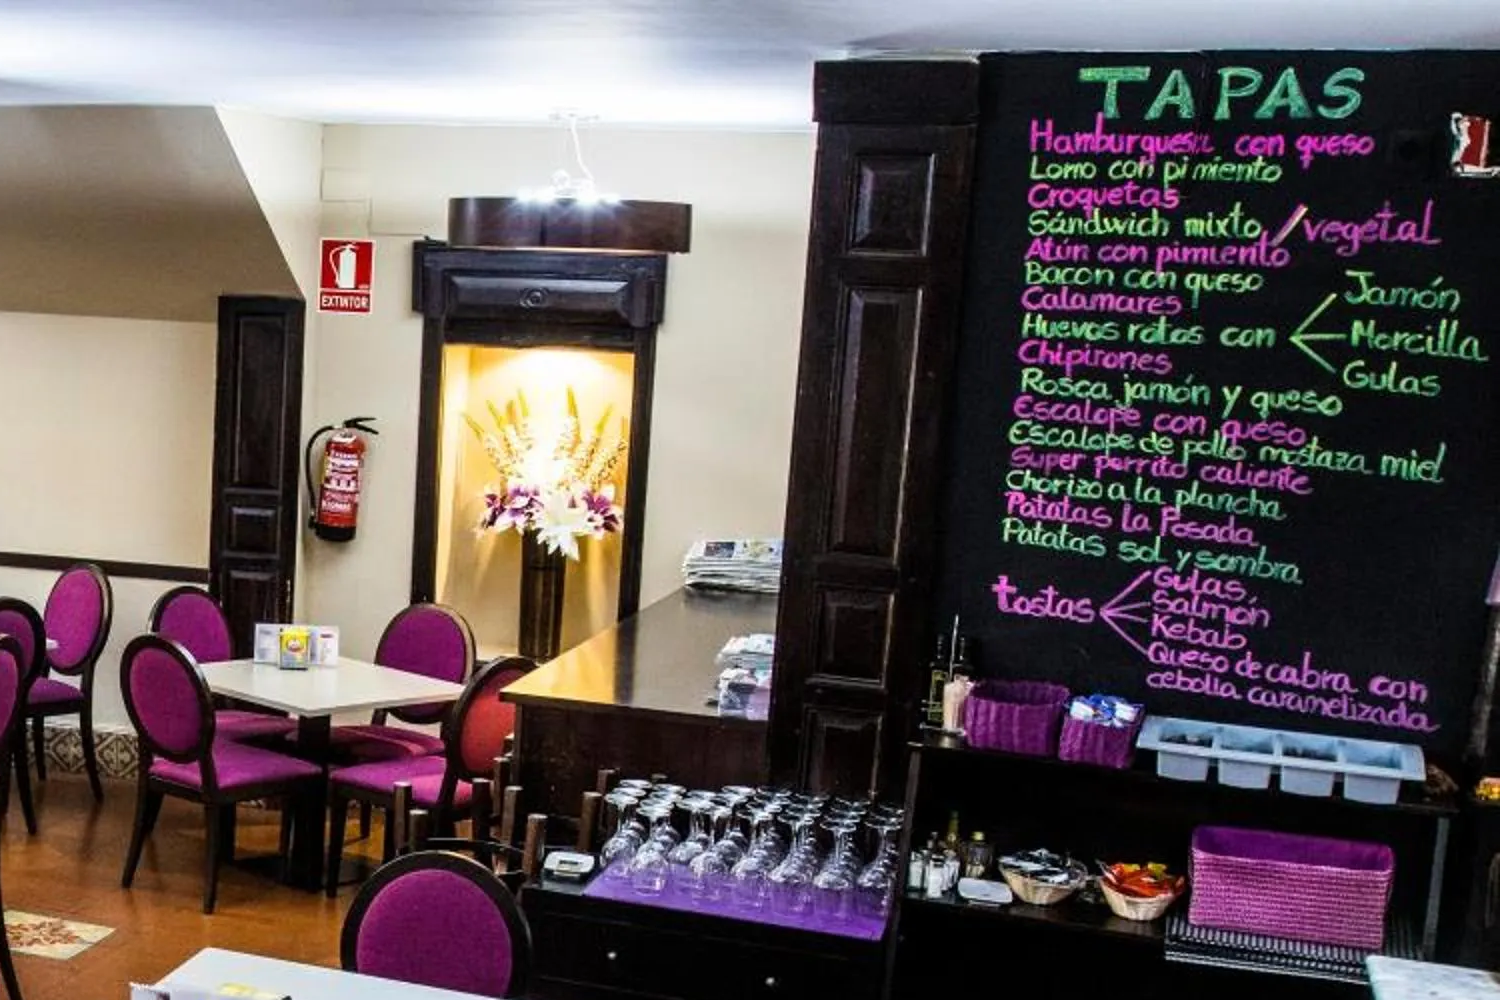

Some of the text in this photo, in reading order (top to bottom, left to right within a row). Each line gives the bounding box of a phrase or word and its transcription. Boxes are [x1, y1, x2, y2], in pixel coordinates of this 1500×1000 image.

[1079, 66, 1365, 120] TAPAS
[1029, 112, 1376, 169] Hamburguesa con queso
[1029, 154, 1097, 181] Lomo
[1108, 158, 1155, 181] con
[1027, 180, 1180, 218] Croquetas
[1027, 207, 1171, 238] Sándwich
[1184, 201, 1263, 239] mixto
[1303, 199, 1442, 257] vegetal
[1024, 230, 1291, 276] Atún con pimiento
[1020, 285, 1183, 316] Calamares
[1024, 260, 1264, 309] Bacon con queso
[1344, 268, 1461, 313] Jamón
[1021, 312, 1276, 348] Huevos rotos con
[1351, 318, 1489, 362] Morcilla
[1017, 338, 1173, 377] Chipirones
[1342, 358, 1442, 398] Gulas
[1020, 366, 1343, 420] Rosca jamón y queso
[1013, 394, 1307, 447] Escalope con queso
[1008, 419, 1446, 483] Escalope de pollo mostaza miel
[1010, 445, 1314, 495] Super perrito caliente
[1004, 490, 1260, 547] Patatas la Posada
[1005, 469, 1287, 521] Chorizo a la plancha
[1001, 517, 1304, 585] Patatas sol y sombra
[991, 574, 1096, 623] tostas
[1152, 565, 1248, 601] Gulas
[1151, 589, 1272, 628] Salmón
[1151, 613, 1248, 650] Kebab
[1148, 642, 1429, 703] Queso de cabra con
[1146, 669, 1442, 732] cebolla caramelizada
